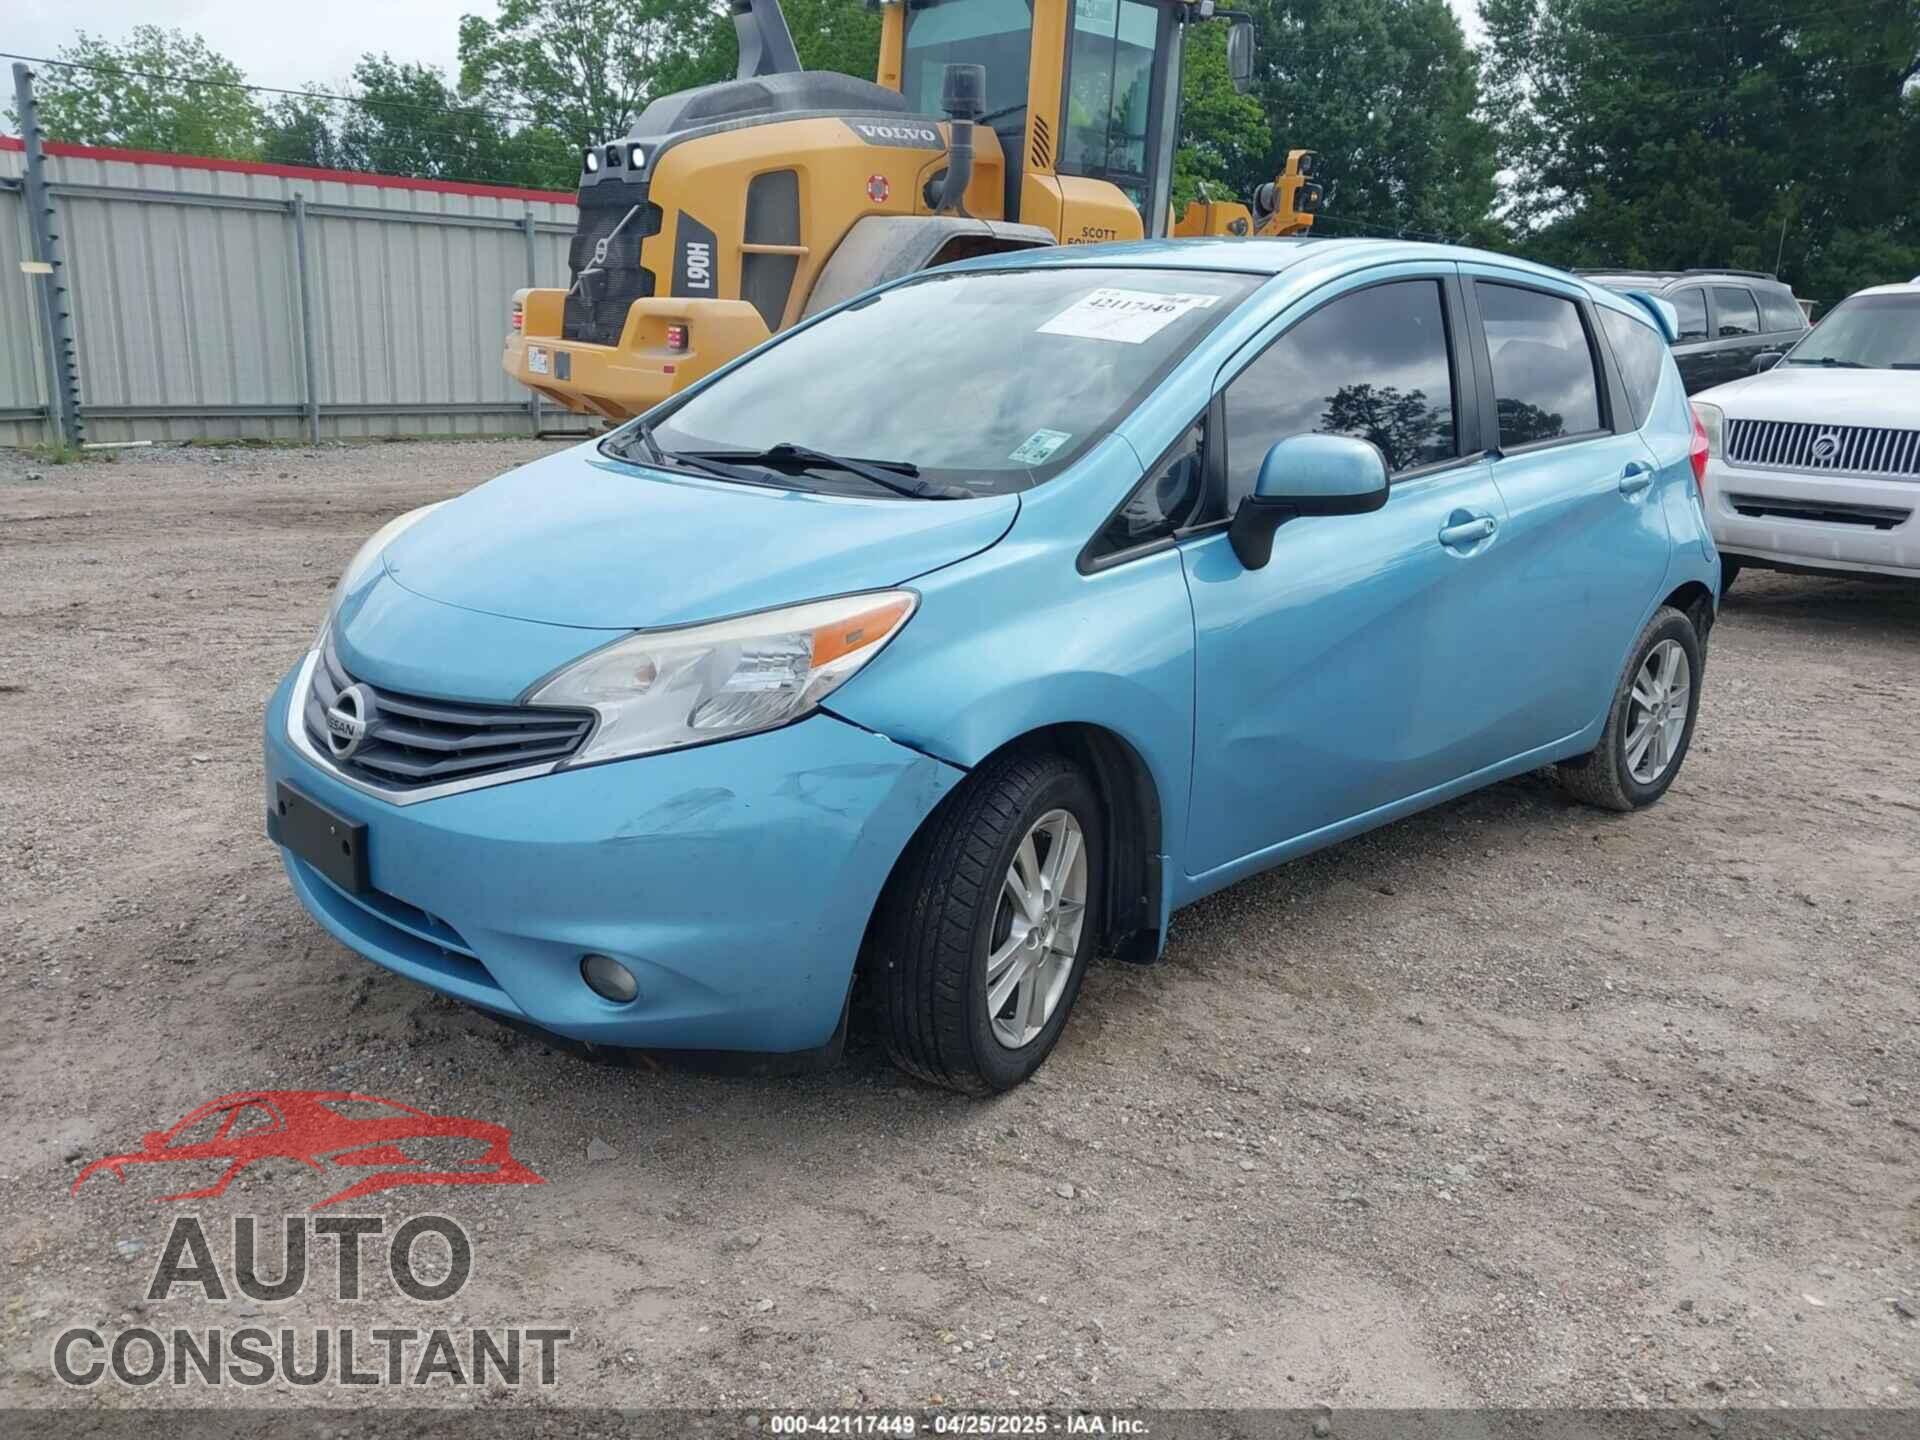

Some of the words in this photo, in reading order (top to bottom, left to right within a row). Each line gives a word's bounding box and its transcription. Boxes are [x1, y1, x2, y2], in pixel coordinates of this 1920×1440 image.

[856, 124, 936, 142] VOLVO
[1081, 226, 1117, 241] SCOTT
[686, 241, 711, 289] L90H
